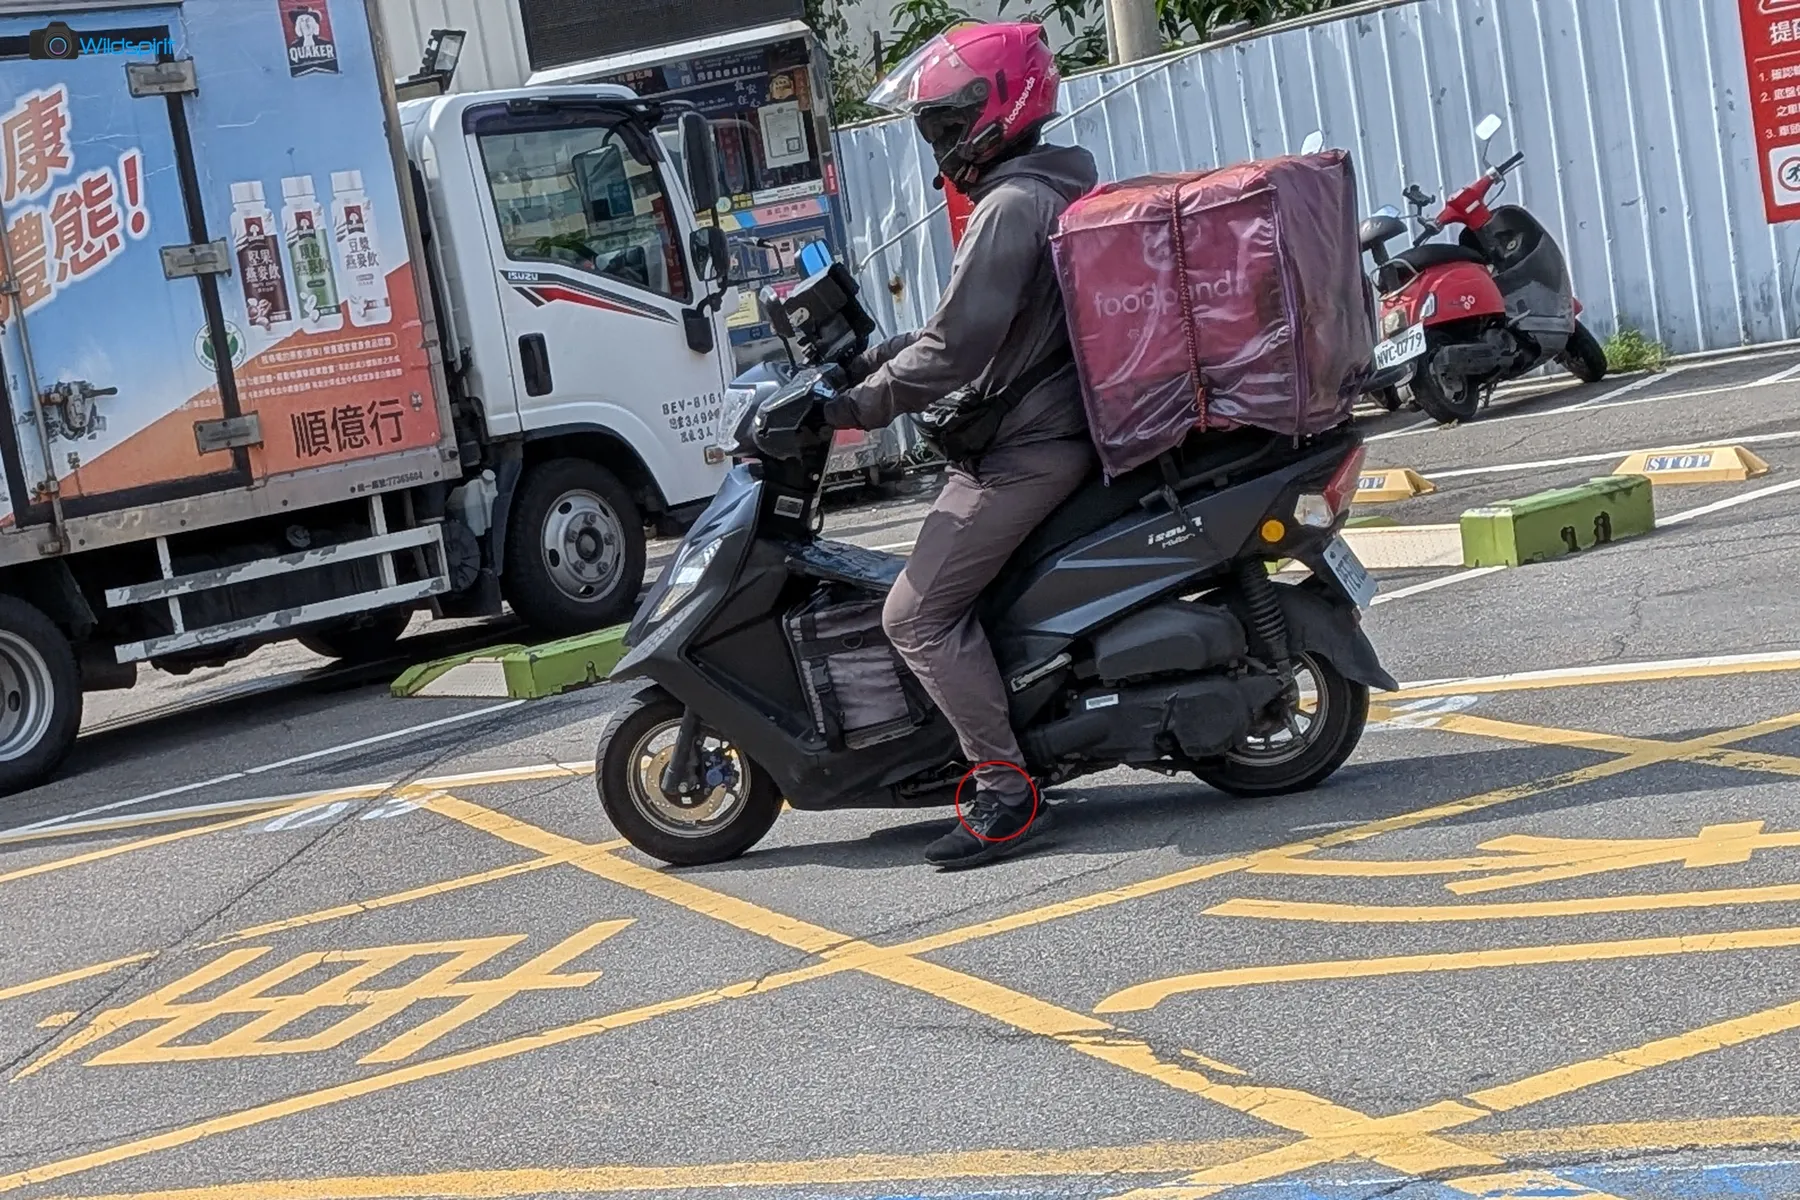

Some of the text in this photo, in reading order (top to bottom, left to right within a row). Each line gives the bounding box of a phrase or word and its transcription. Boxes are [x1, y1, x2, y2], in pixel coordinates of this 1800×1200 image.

[289, 44, 334, 63] QUAKER
[1004, 76, 1036, 124] foodpanda
[2, 89, 70, 202] 康
[508, 271, 539, 281] ISUZU
[290, 398, 405, 459] 順億行
[1646, 453, 1711, 471] STOP
